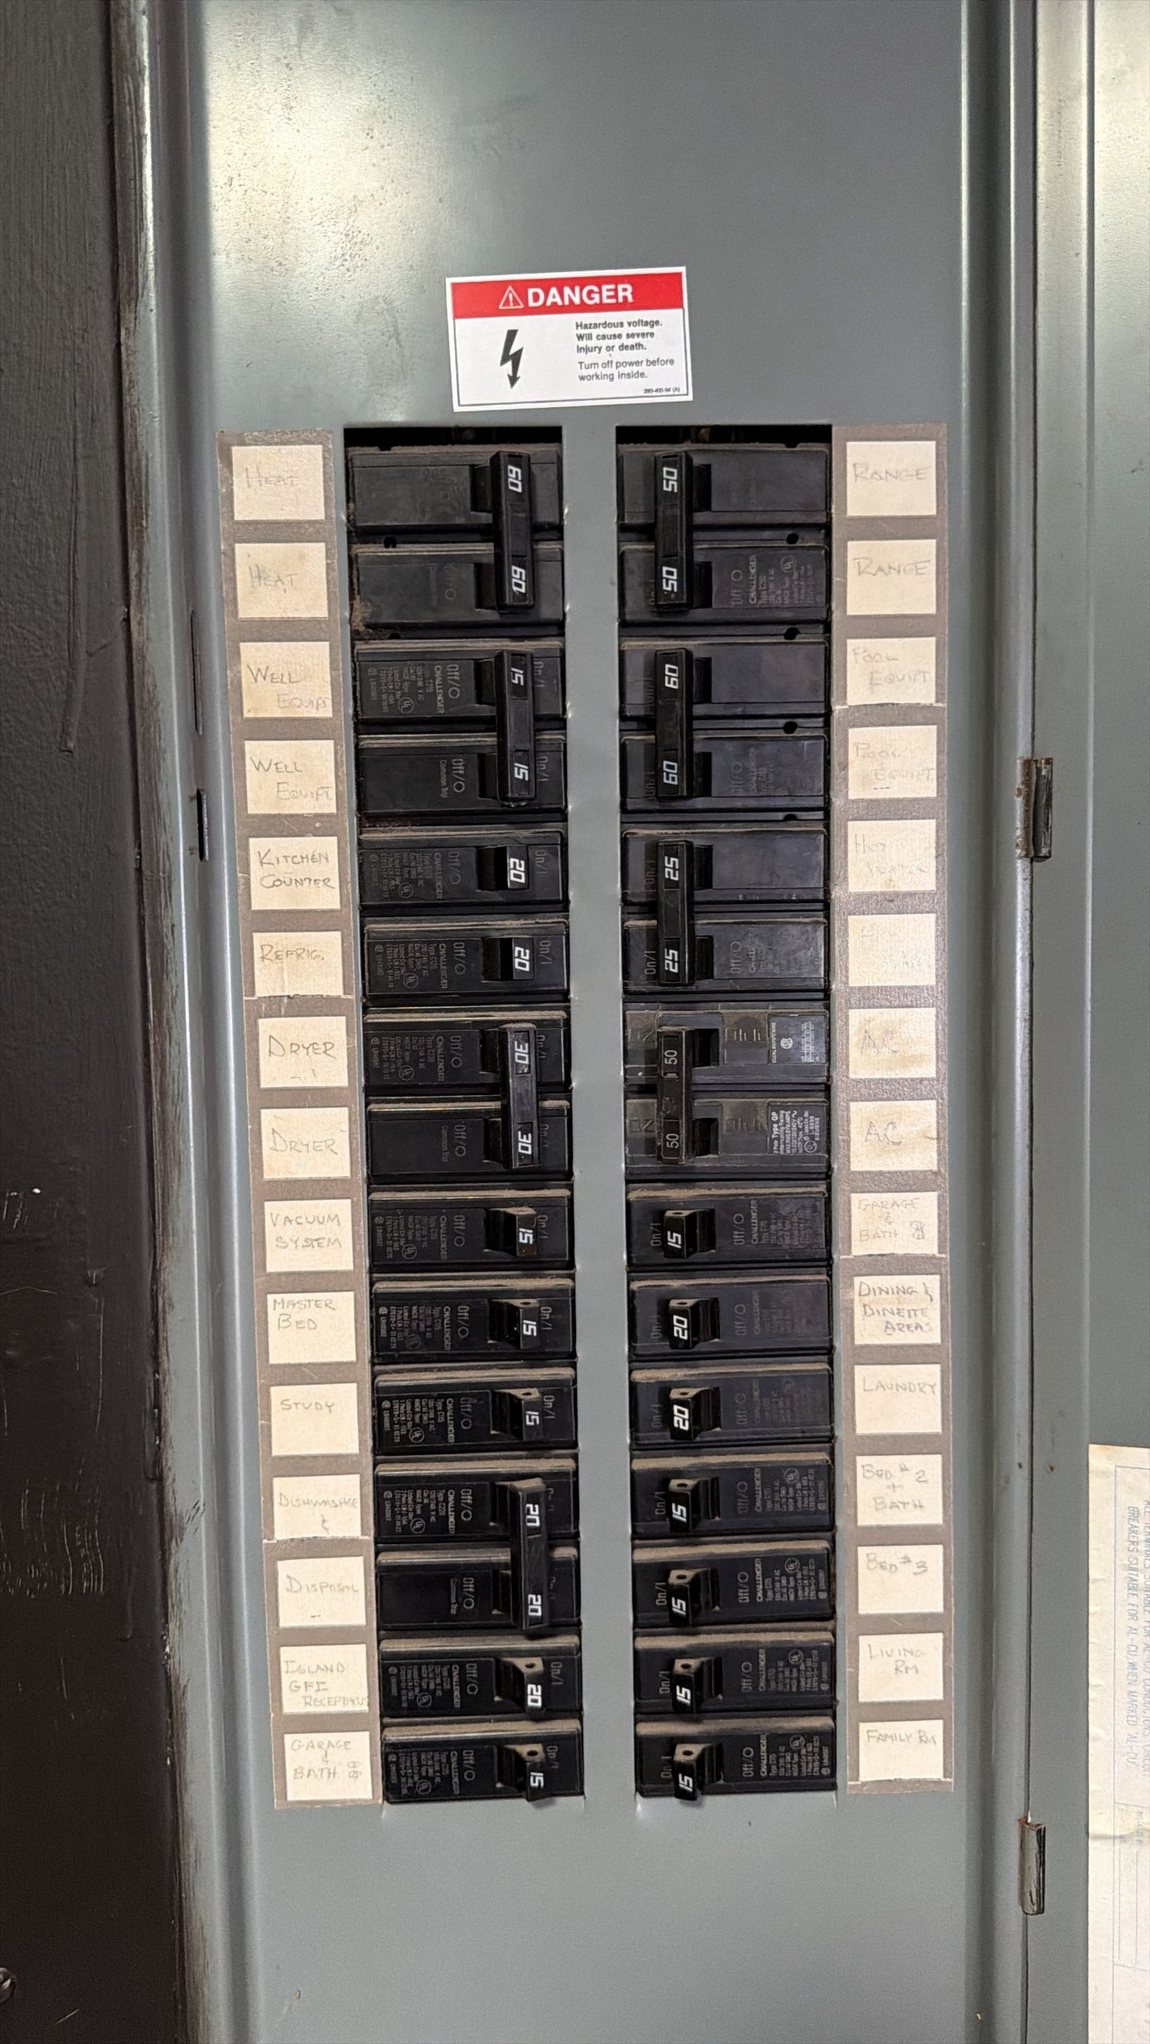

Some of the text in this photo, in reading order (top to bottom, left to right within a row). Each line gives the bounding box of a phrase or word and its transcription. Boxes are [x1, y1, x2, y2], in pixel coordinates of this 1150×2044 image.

[527, 284, 634, 307] DANGER
[575, 318, 663, 331] Hazardous voltage.
[576, 331, 655, 342] Will cause severe
[618, 342, 647, 352] death.
[578, 357, 675, 370] Turn off power before
[578, 370, 648, 382] working inside.
[508, 465, 522, 493] 60
[662, 467, 677, 493] 50
[853, 463, 932, 483] RANGE
[248, 563, 298, 588] HEAT
[852, 557, 930, 576] RANGE
[511, 565, 525, 593] 60
[662, 567, 677, 593] 50
[247, 665, 300, 684] WELL
[511, 667, 524, 686] 15
[665, 663, 679, 689] 60
[435, 665, 444, 714] CHALLENGER
[250, 757, 302, 773] WELL
[514, 763, 528, 781] 15
[663, 760, 678, 785] 60
[258, 849, 329, 866] KITCHEN
[510, 858, 526, 883] 20
[664, 856, 679, 881] 25
[260, 874, 336, 889] COUNTER
[514, 947, 530, 972] 20
[664, 948, 679, 973] 25
[269, 1035, 336, 1059] DRYER
[514, 1041, 529, 1065] 30
[664, 1049, 678, 1066] 50
[771, 1111, 779, 1120] QP
[771, 1123, 780, 1138] Type
[865, 1121, 902, 1145] AC
[270, 1128, 338, 1155] DRYER
[517, 1131, 532, 1155] 30
[666, 1133, 680, 1149] 50
[859, 1197, 920, 1211] GARAGE
[270, 1213, 341, 1227] VACUUM
[275, 1237, 342, 1249] SYSTEM
[519, 1228, 533, 1244] 15
[667, 1230, 682, 1249] 15
[859, 1229, 899, 1241] BATH
[858, 1281, 918, 1297] DINING
[273, 1298, 336, 1311] MASTER
[277, 1313, 318, 1330] BED
[523, 1320, 537, 1336] 15
[673, 1314, 688, 1340] 20
[862, 1378, 937, 1395] LAUNDRY
[280, 1399, 335, 1413] STUDY
[525, 1411, 540, 1426] 15
[673, 1404, 689, 1431] 20
[672, 1502, 687, 1522] 15
[873, 1497, 925, 1511] BATH
[1127, 1506, 1140, 1553] BREAKERS
[1127, 1557, 1139, 1599] SUITABLE
[528, 1594, 542, 1616] 20
[672, 1597, 687, 1616] 15
[1127, 1602, 1139, 1621] FOR
[867, 1643, 926, 1659] LIVING
[895, 1660, 919, 1675] RM
[1127, 1662, 1138, 1686] WHEN
[527, 1684, 542, 1707] 20
[676, 1685, 692, 1707] 15
[1127, 1690, 1138, 1727] MARKED
[291, 1739, 352, 1751] GARAGE
[866, 1729, 912, 1744] FAMILY
[293, 1766, 338, 1780] BATH
[530, 1772, 545, 1789] 15
[679, 1773, 693, 1792] 15
